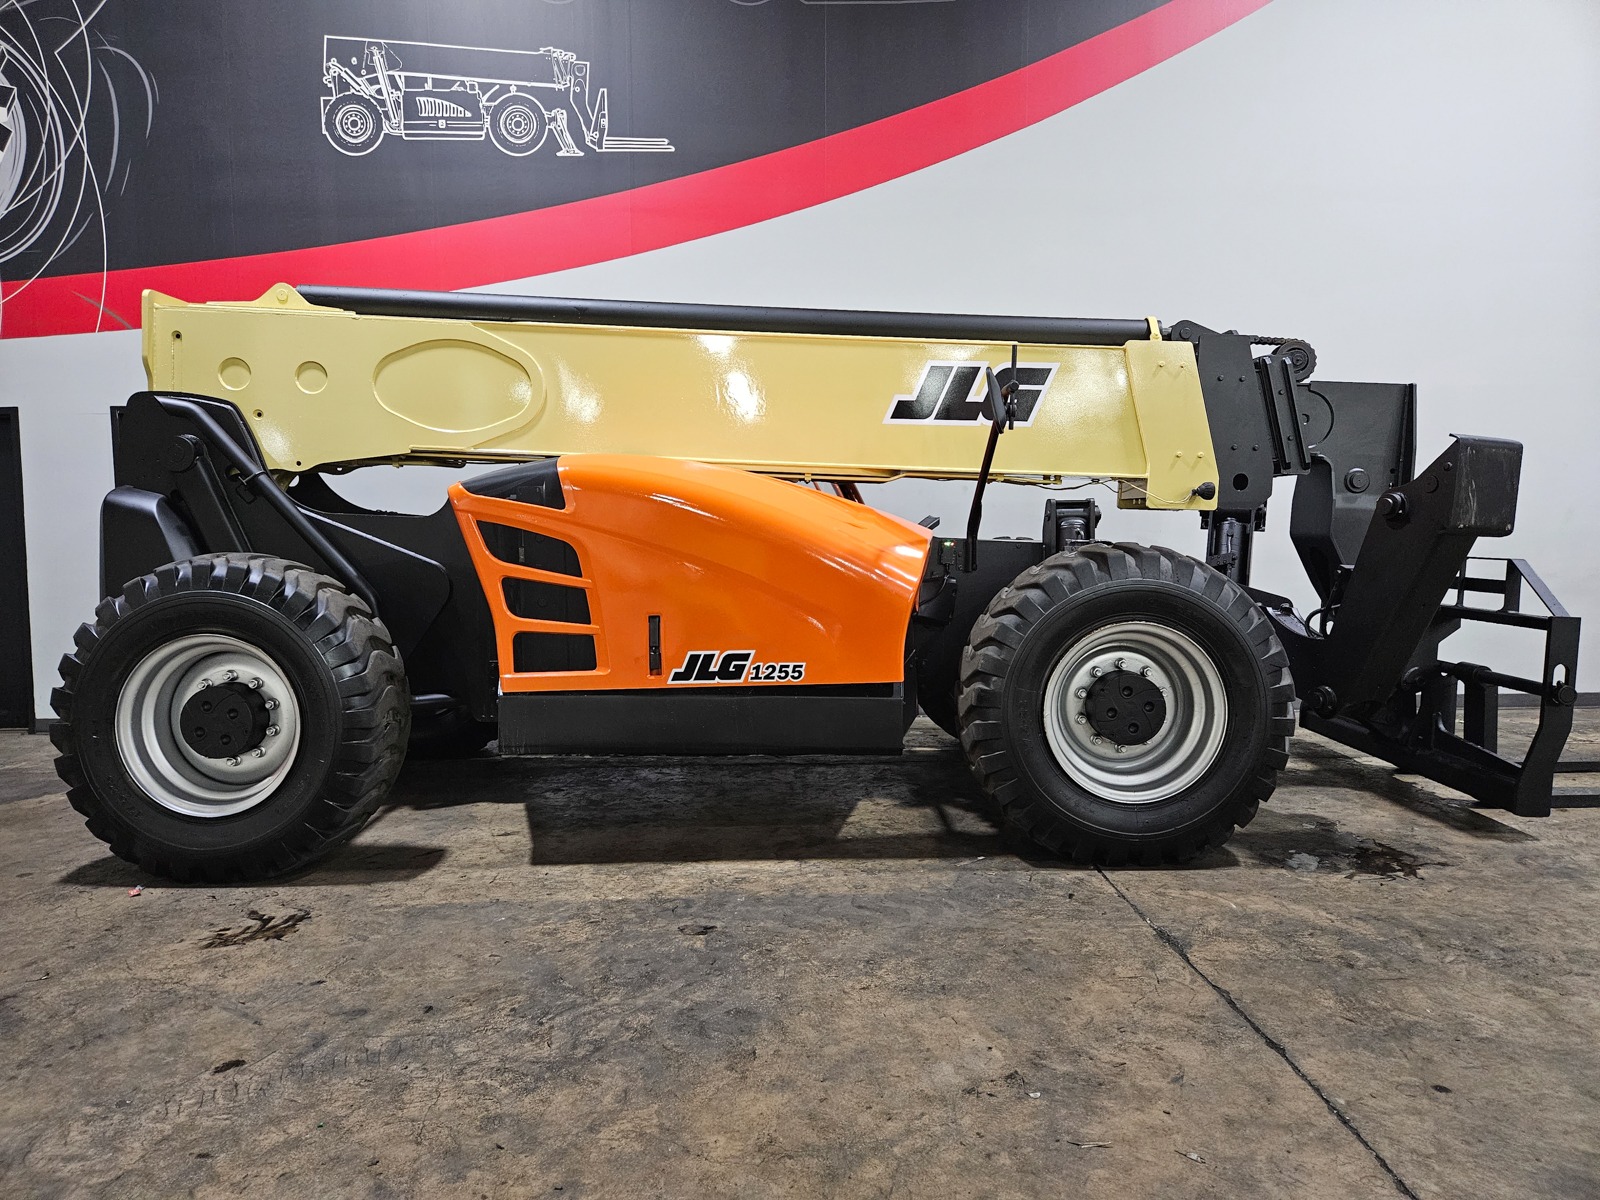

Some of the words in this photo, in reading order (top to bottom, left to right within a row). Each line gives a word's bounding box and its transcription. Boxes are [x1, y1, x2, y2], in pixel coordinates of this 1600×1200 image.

[888, 364, 1054, 424] JLG
[670, 652, 752, 682] JLG
[750, 664, 804, 681] 1255
